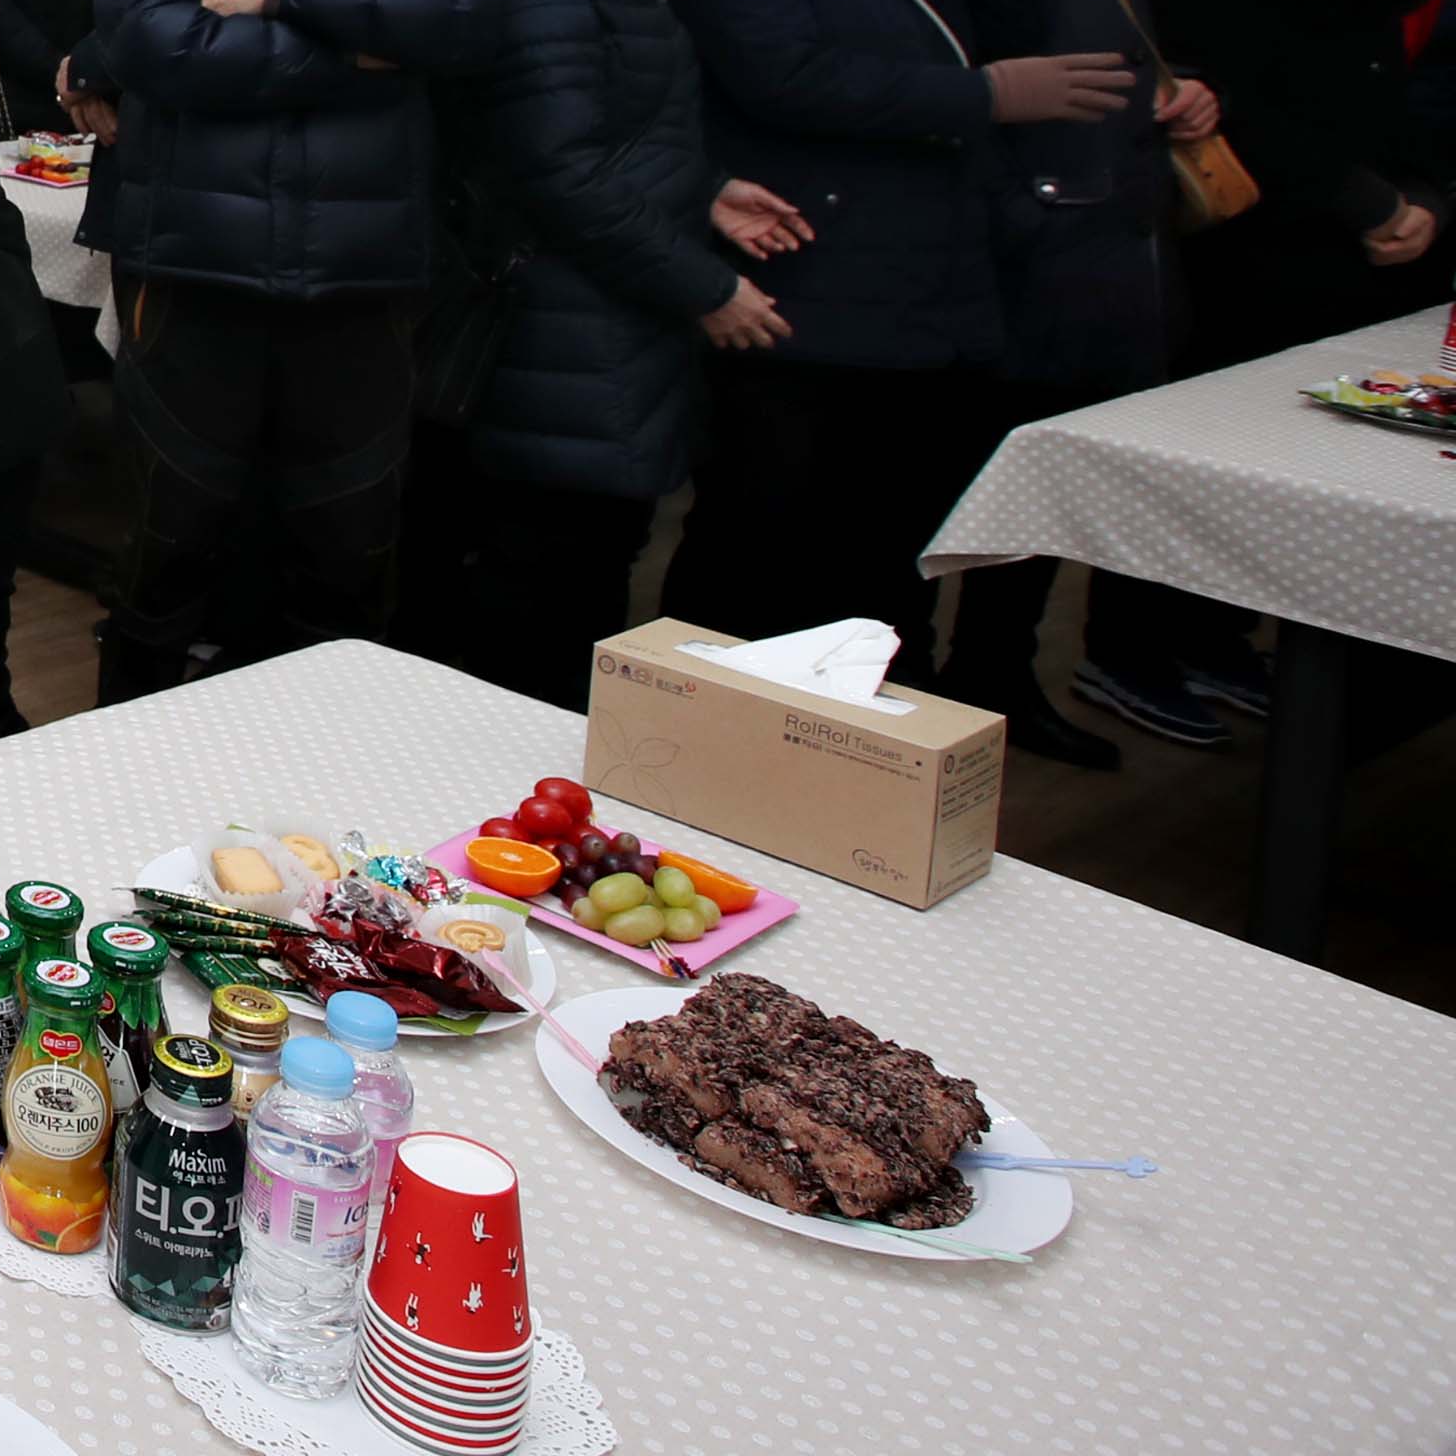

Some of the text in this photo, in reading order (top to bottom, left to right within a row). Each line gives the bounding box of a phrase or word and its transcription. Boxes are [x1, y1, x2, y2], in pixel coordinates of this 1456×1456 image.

[853, 736, 903, 763] Tissues
[19, 1073, 98, 1104] ORANGE JUICE
[16, 1104, 99, 1135] 오렌지주스100
[168, 1148, 227, 1174] Maxim
[172, 1170, 227, 1187] 에스프레소
[134, 1227, 214, 1259] 스위트 아메리카노
